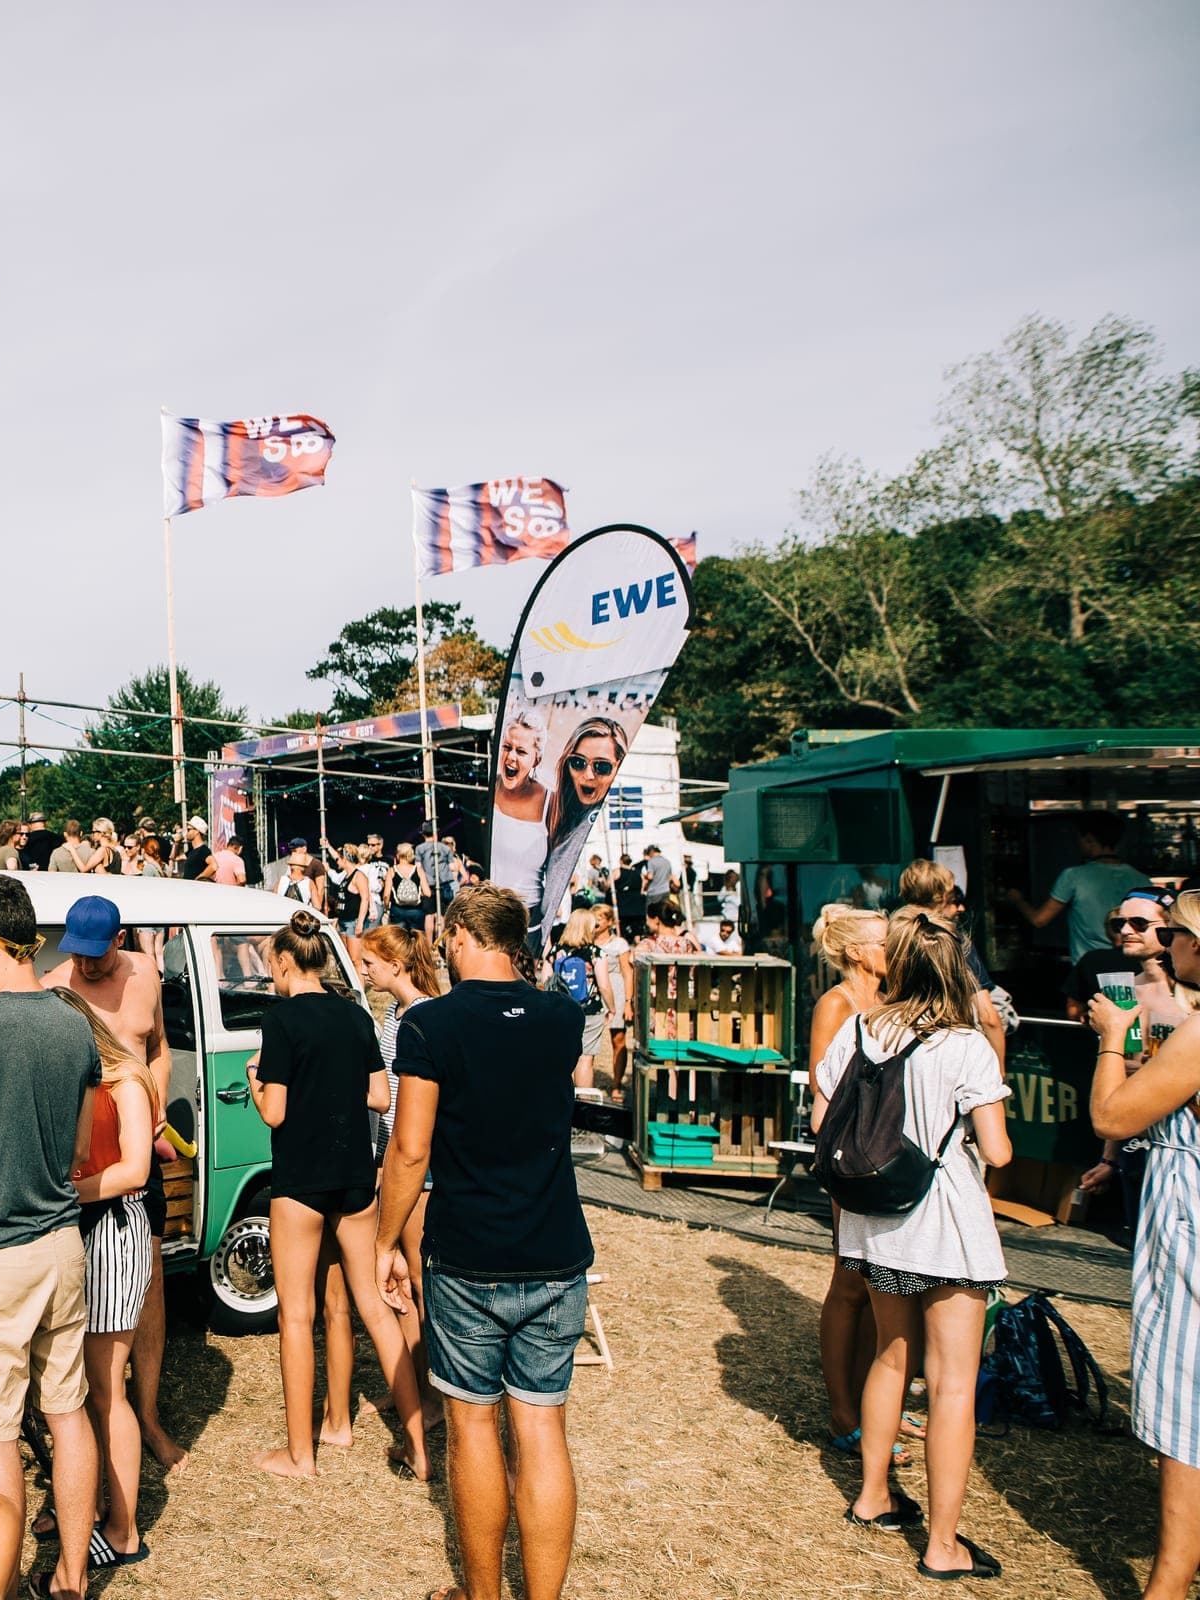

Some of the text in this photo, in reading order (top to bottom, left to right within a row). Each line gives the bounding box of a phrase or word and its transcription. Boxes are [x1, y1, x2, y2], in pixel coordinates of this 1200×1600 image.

[488, 477, 543, 507] WE
[591, 572, 677, 625] EWE
[1102, 984, 1133, 1001] EVER
[1005, 1072, 1078, 1123] EVER
